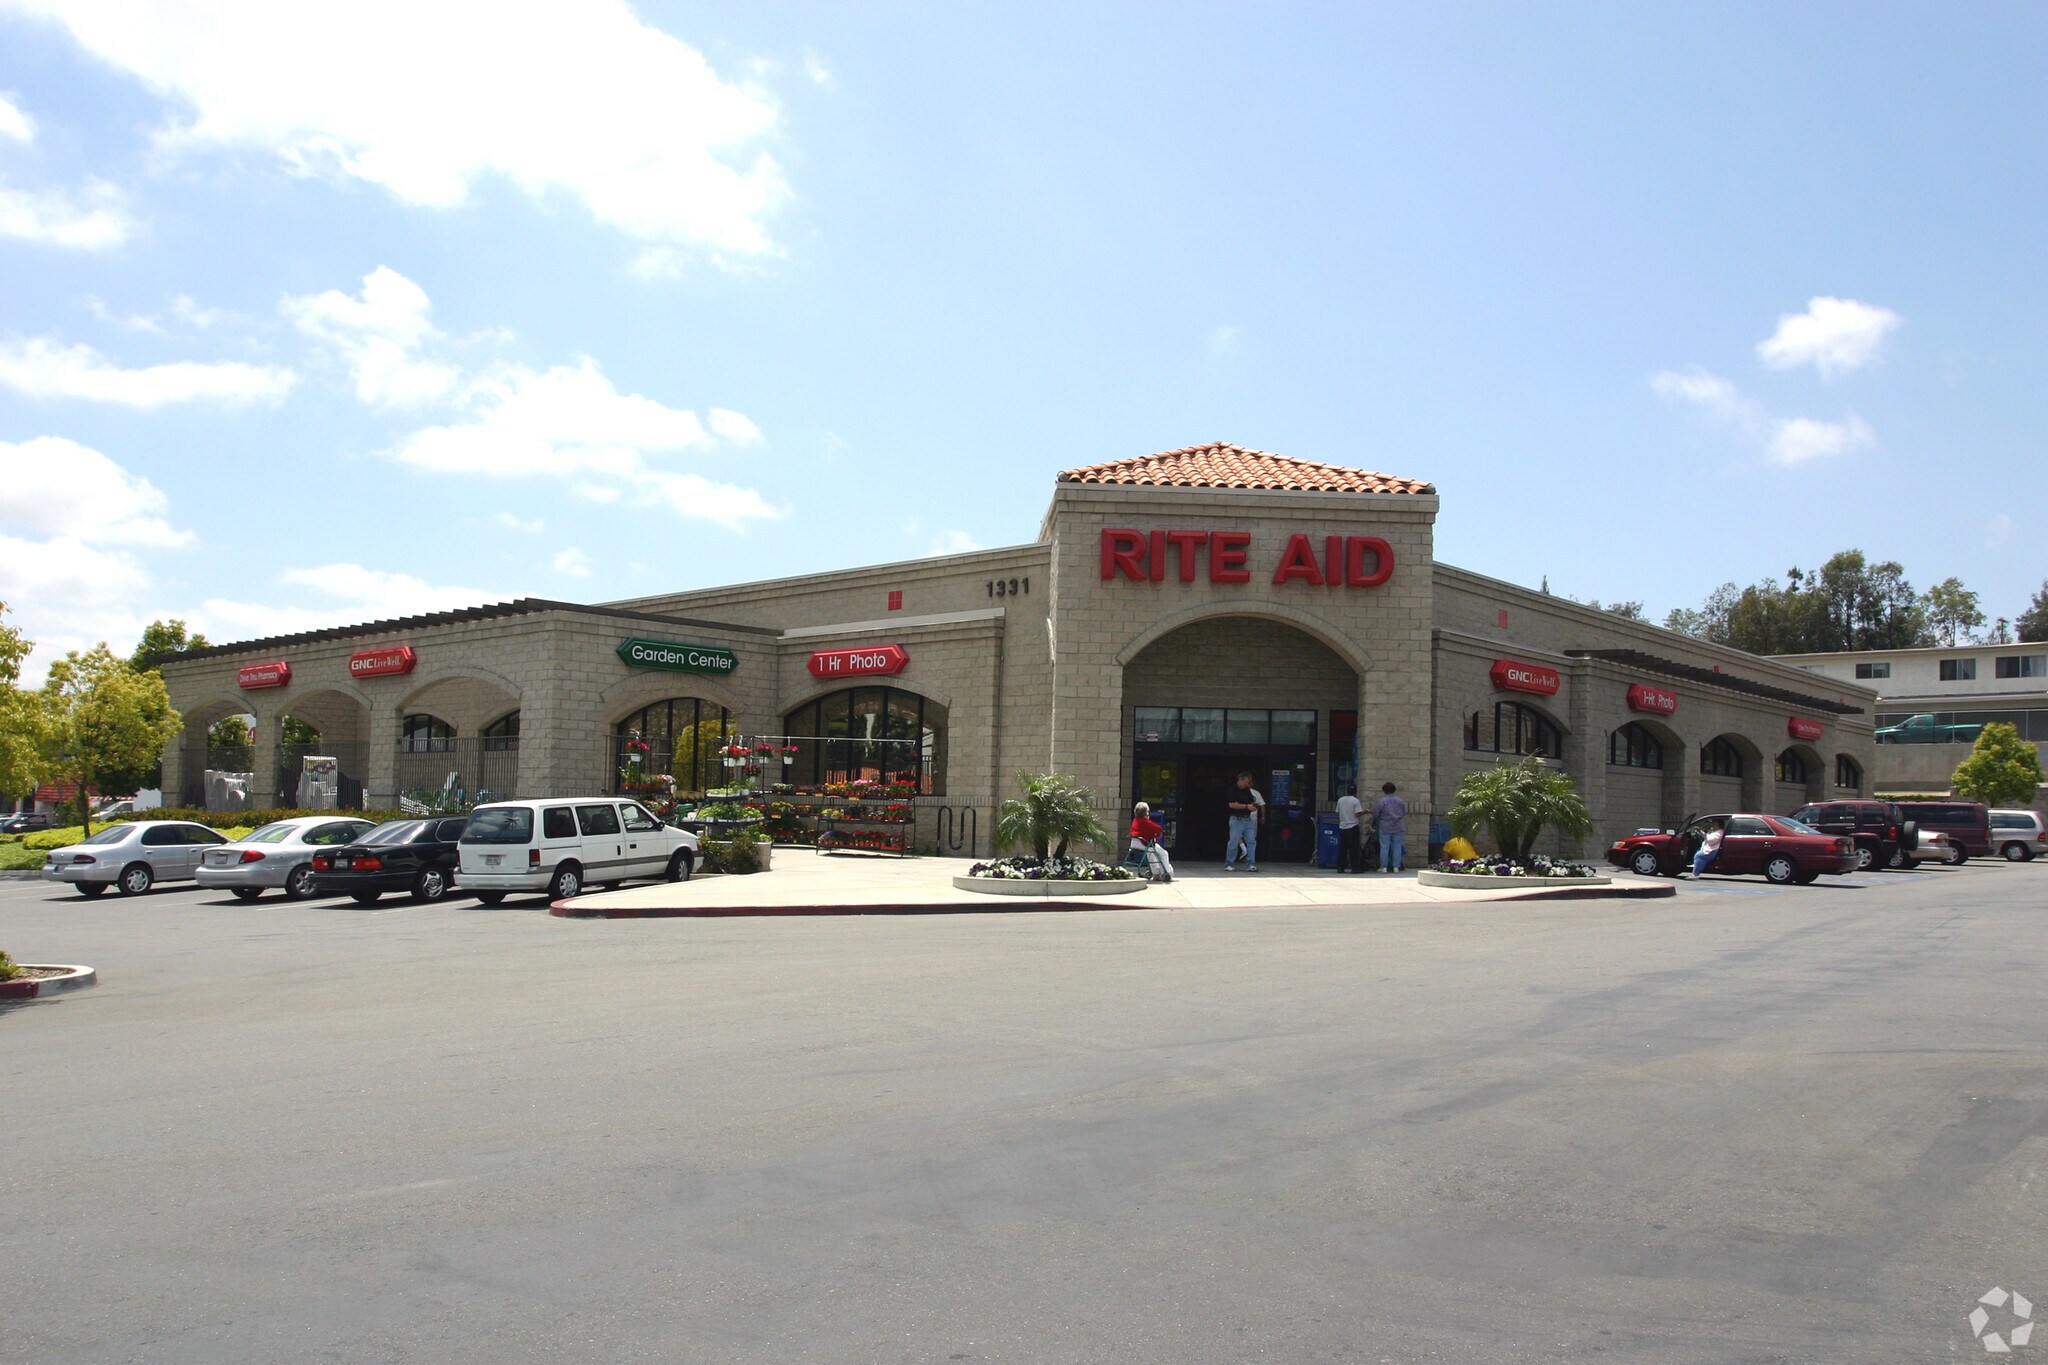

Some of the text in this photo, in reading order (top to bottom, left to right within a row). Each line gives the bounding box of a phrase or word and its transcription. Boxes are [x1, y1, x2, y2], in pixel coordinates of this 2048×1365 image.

[1101, 528, 1395, 587] RITE AID
[985, 577, 1029, 598] 1331
[351, 658, 374, 670] GNC
[631, 645, 732, 669] Garden Center
[819, 652, 886, 671] 1 Hr Photo
[1508, 669, 1530, 683] GNC
[1657, 693, 1674, 710] Photo
